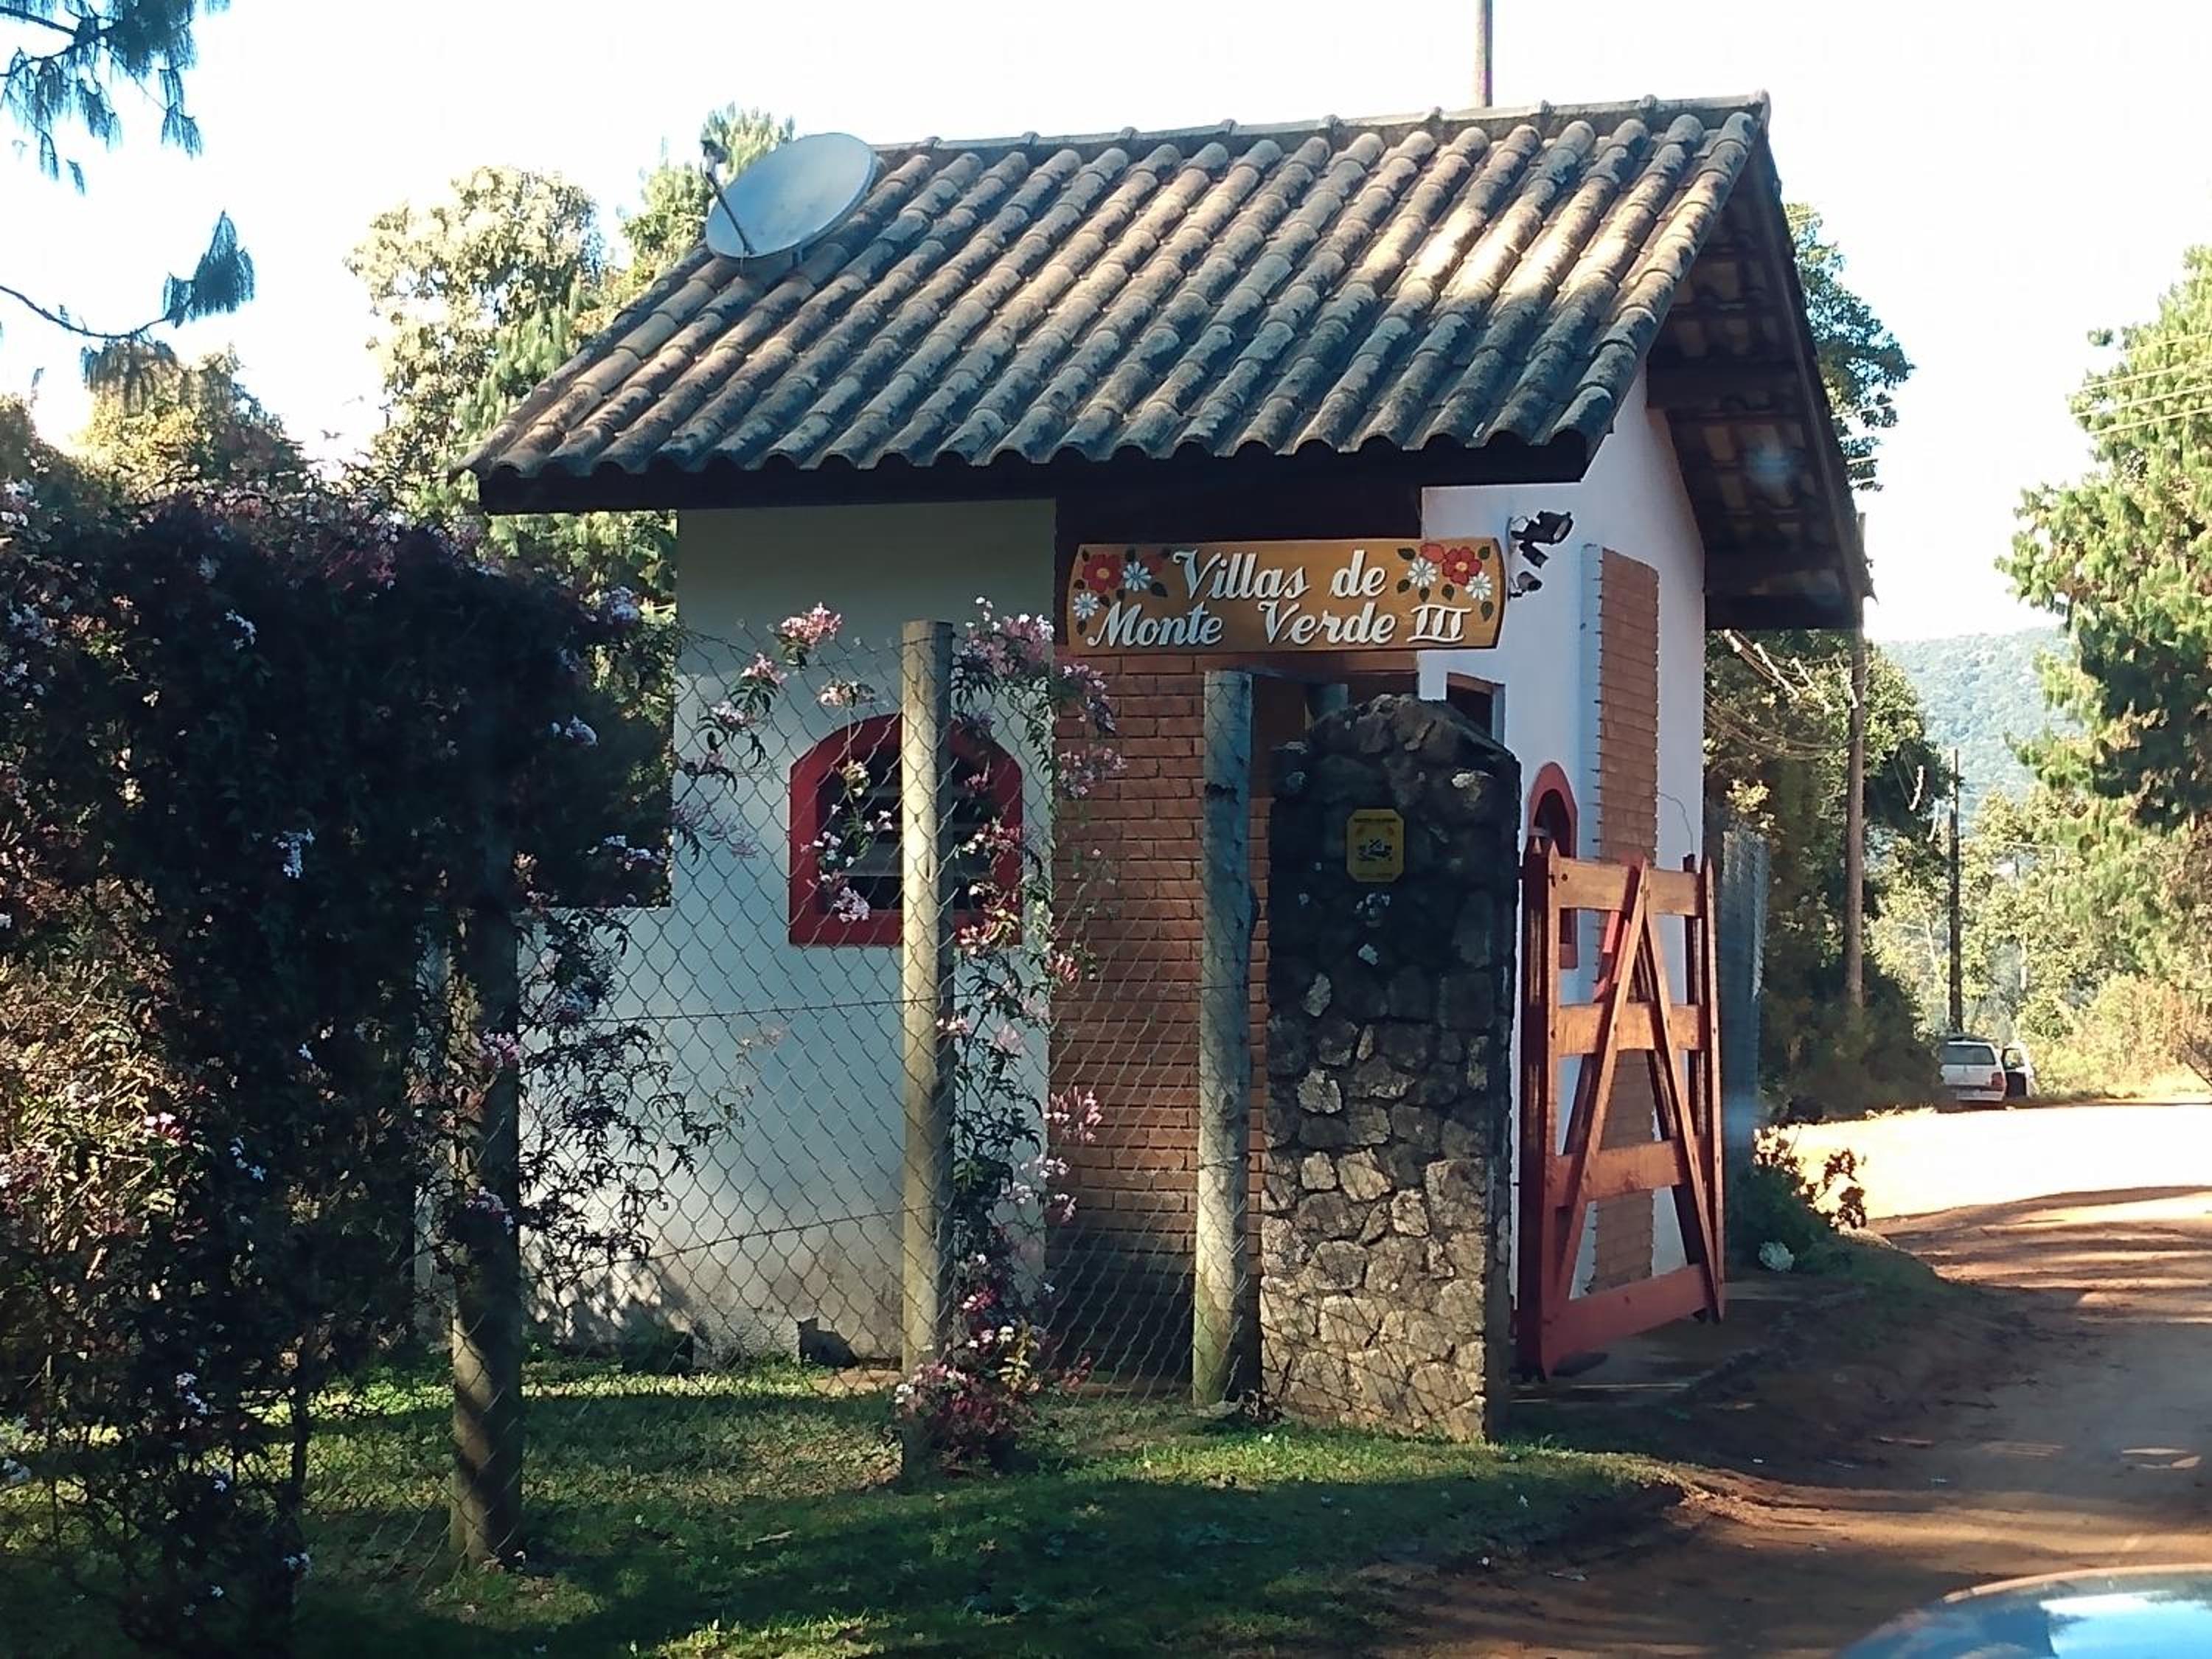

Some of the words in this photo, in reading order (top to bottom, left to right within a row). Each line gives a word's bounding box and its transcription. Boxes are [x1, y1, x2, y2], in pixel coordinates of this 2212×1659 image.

[1173, 549, 1310, 599] Villas
[1330, 549, 1385, 598] de
[1088, 602, 1222, 647] Monte
[1258, 599, 1396, 646] Verde
[1406, 604, 1472, 643] III
